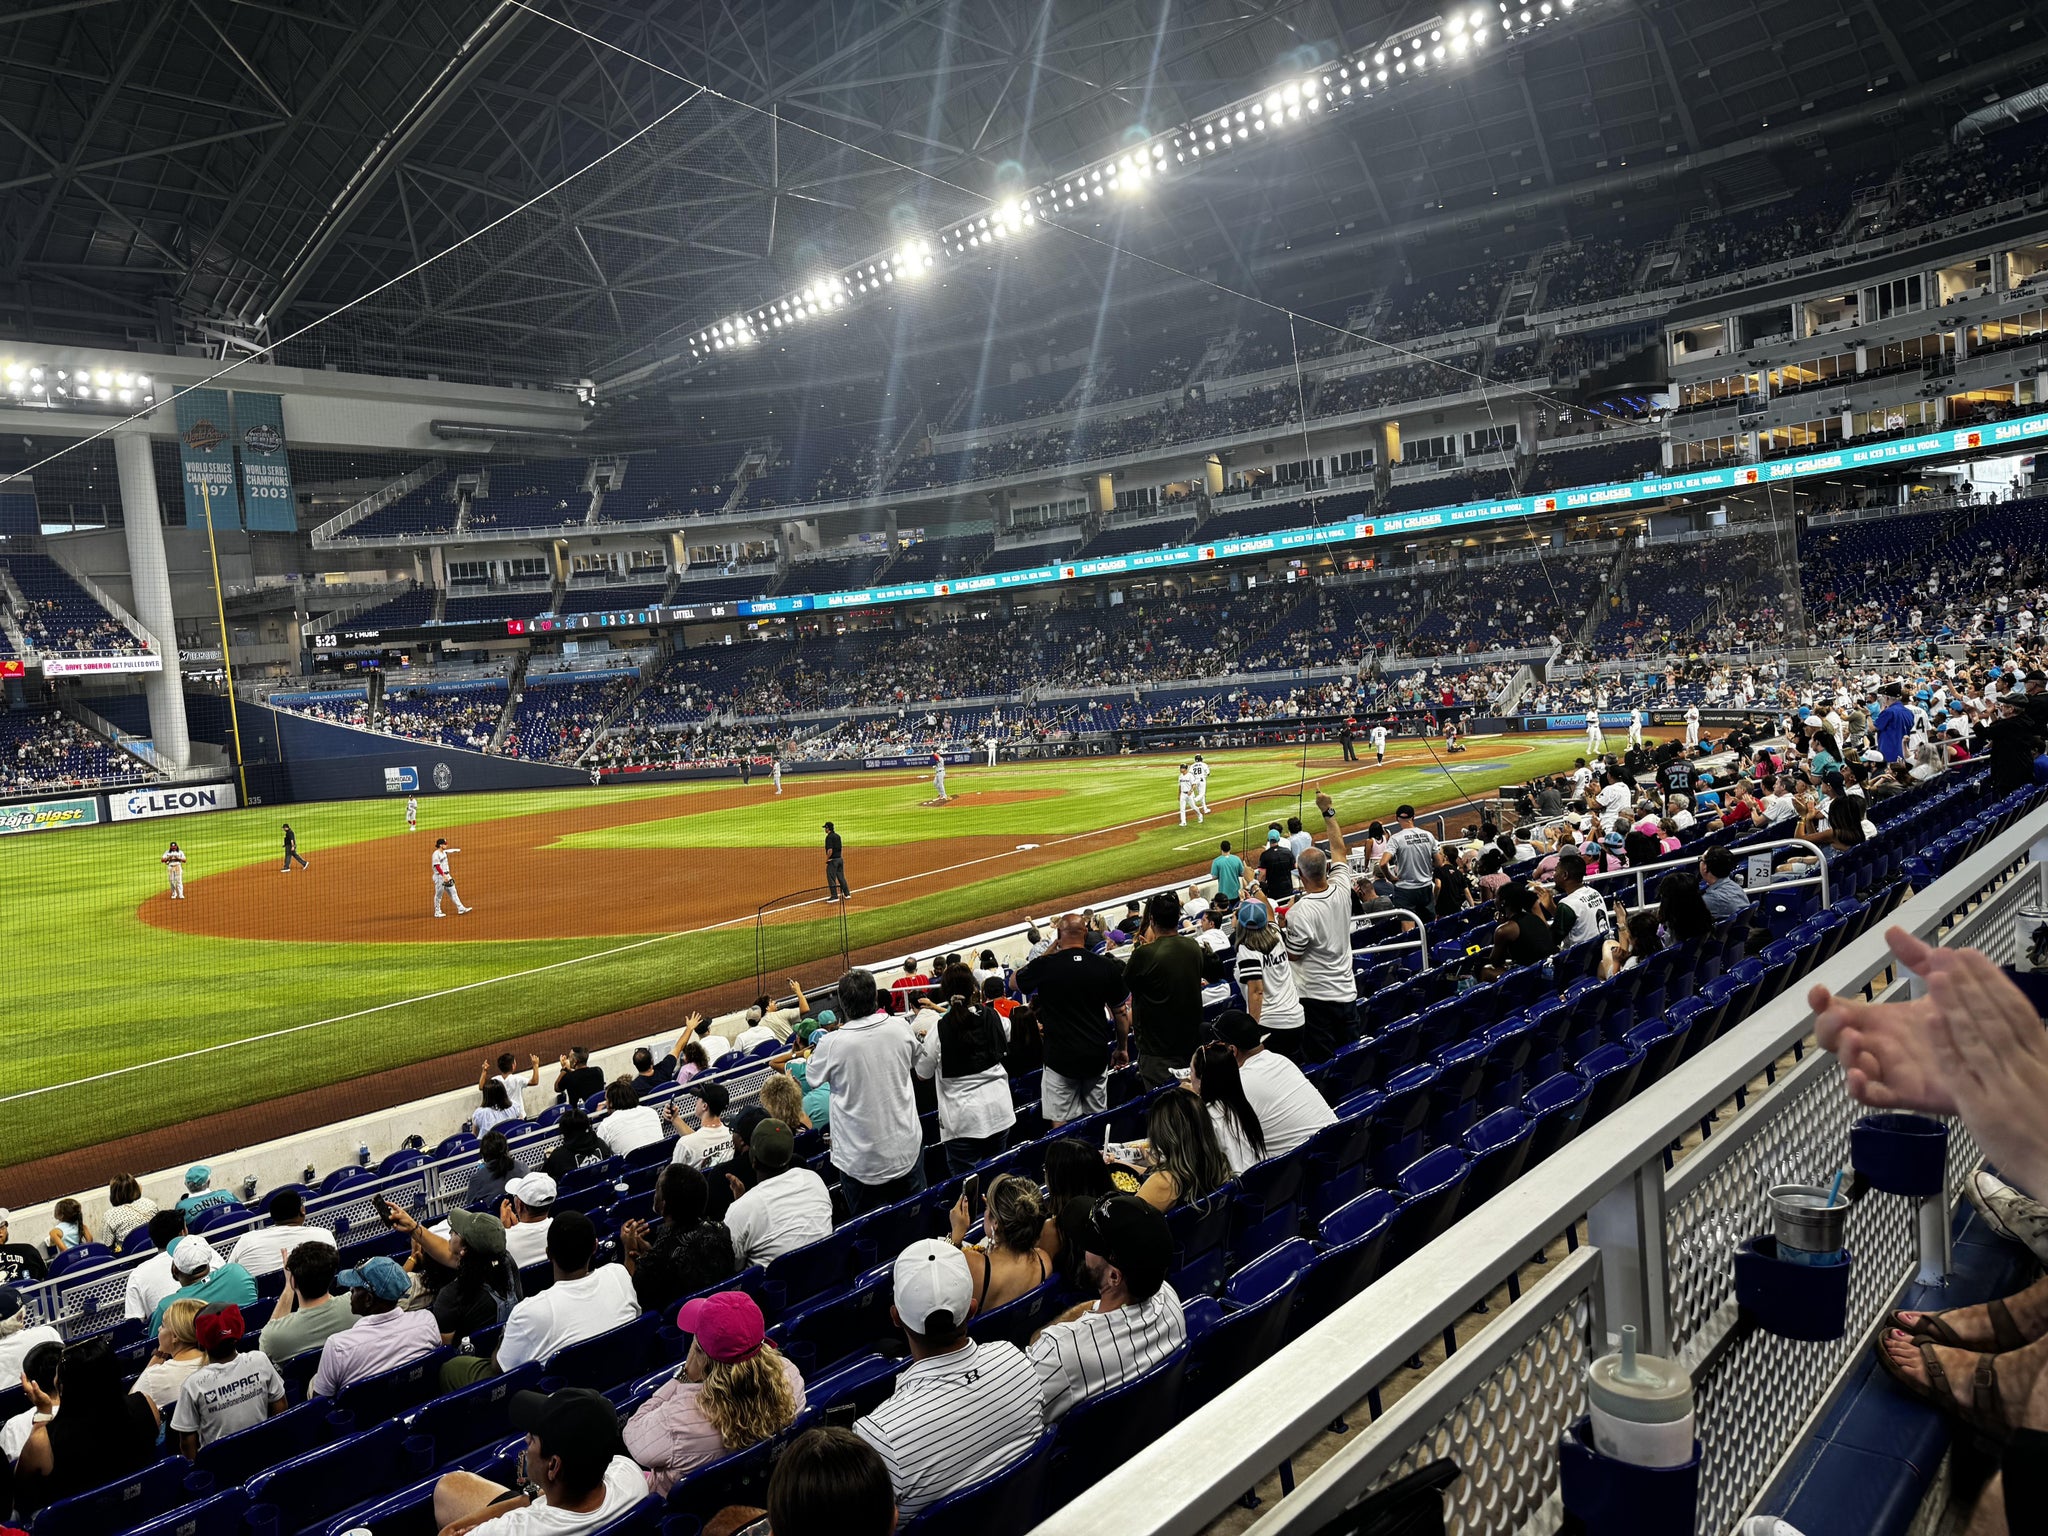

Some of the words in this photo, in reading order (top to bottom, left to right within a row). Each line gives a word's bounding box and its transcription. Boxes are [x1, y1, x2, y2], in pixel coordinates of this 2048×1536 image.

[1995, 424, 2021, 440] SUN
[1854, 451, 1868, 461] REAL
[1870, 449, 1884, 459] ICED
[1885, 447, 1898, 456] TEA.
[1899, 444, 1915, 454] REAL
[1916, 440, 1942, 450] VODKA.
[185, 462, 208, 472] WORLD
[209, 463, 232, 473] SERIES
[245, 464, 266, 474] WORLD
[1770, 464, 1794, 477] SUN
[1795, 456, 1842, 473] CRUISER
[186, 473, 232, 484] CHAMPIONS
[246, 475, 289, 486] CHAMPIONS
[1643, 485, 1657, 493] REAL
[1658, 483, 1672, 492] ICED
[1686, 478, 1700, 488] REAL
[252, 487, 287, 498] 2003
[1567, 493, 1588, 506] SUN
[1590, 488, 1632, 502] CRUISER
[1452, 511, 1464, 520] REAL
[1464, 509, 1476, 518] ICED
[1384, 520, 1401, 531] SUN
[1403, 514, 1442, 528] CRUISER
[1223, 544, 1239, 554] SUN
[1240, 539, 1274, 552] CRUISER
[752, 602, 776, 612] STOWERS
[673, 610, 695, 619] LITTELL
[516, 623, 520, 632] 4
[529, 621, 535, 632] 4
[583, 616, 589, 627] 0
[602, 615, 607, 626] B
[610, 615, 615, 625] 3
[620, 614, 625, 624] S
[628, 614, 634, 624] 2
[316, 635, 337, 647] 5:23
[1665, 765, 1690, 775] STOWERS
[1669, 774, 1688, 789] 28
[148, 790, 216, 811] LEON
[248, 796, 261, 805] 335
[35, 809, 83, 822] Blast
[1755, 868, 1769, 877] 23
[6, 1255, 24, 1264] CLUB
[218, 1372, 260, 1396] IMPACT
